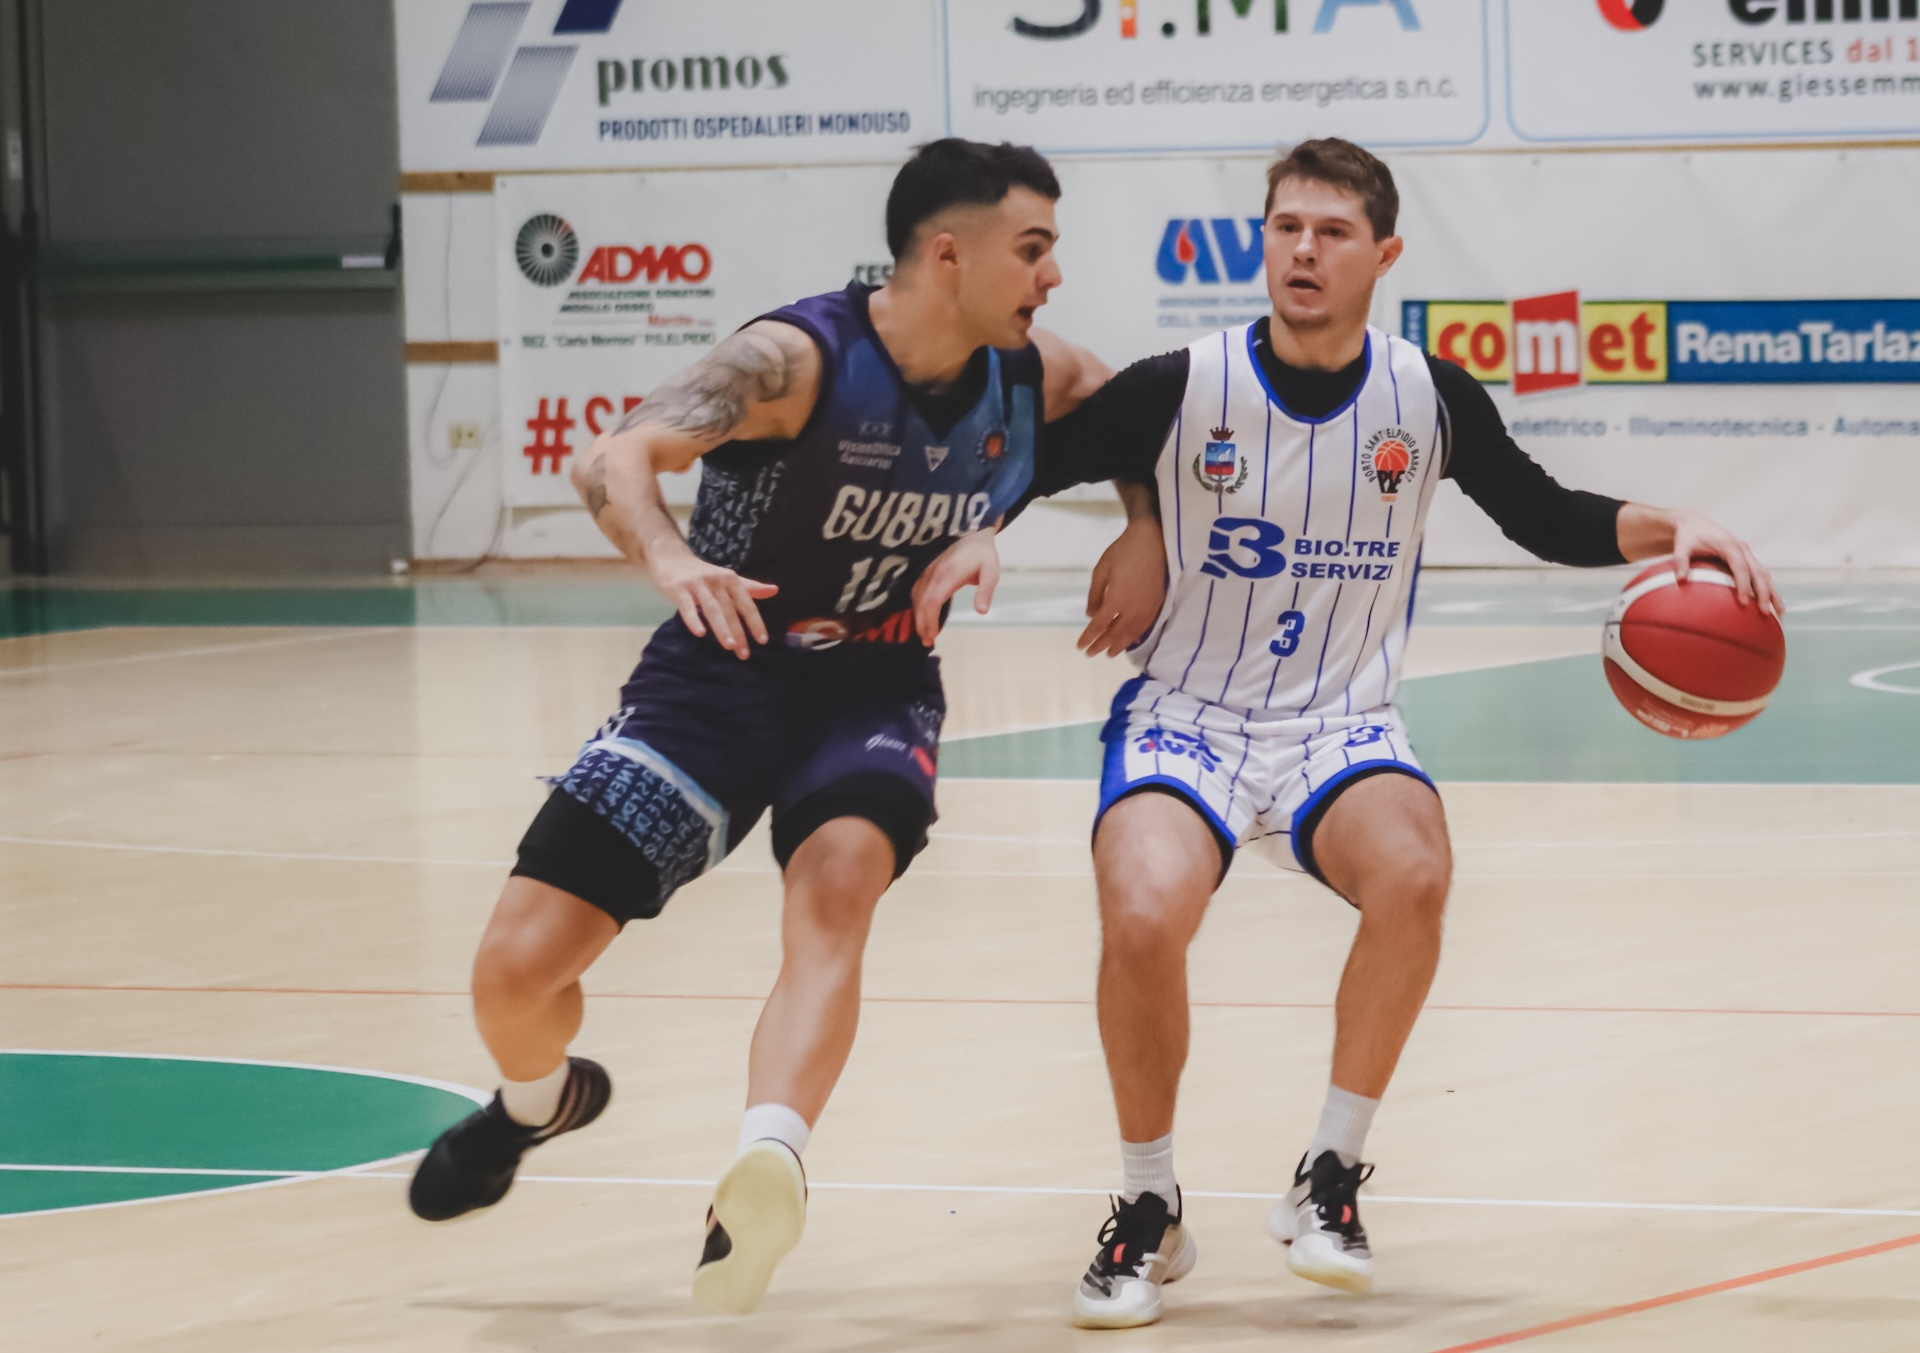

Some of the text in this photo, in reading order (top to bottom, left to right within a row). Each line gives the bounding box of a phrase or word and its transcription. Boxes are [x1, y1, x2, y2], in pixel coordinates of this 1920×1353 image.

[1692, 41, 1834, 68] SERVICES
[1846, 38, 1893, 64] dal
[597, 52, 789, 106] promos
[974, 76, 1460, 115] ingegneria ed efficienza energetica s.n.c.
[600, 110, 912, 142] PRODOTTI OSPEDALIERI MONOUSO
[577, 243, 713, 285] ADMO
[1437, 311, 1657, 374] comet
[1511, 415, 1608, 437] elettrico
[1361, 453, 1378, 483] PORTO
[1404, 448, 1419, 483] BASKET
[1293, 538, 1401, 558] BIO.TRE
[834, 554, 910, 614] 10
[1290, 563, 1394, 581] SERVIZI
[1269, 610, 1305, 658] 3
